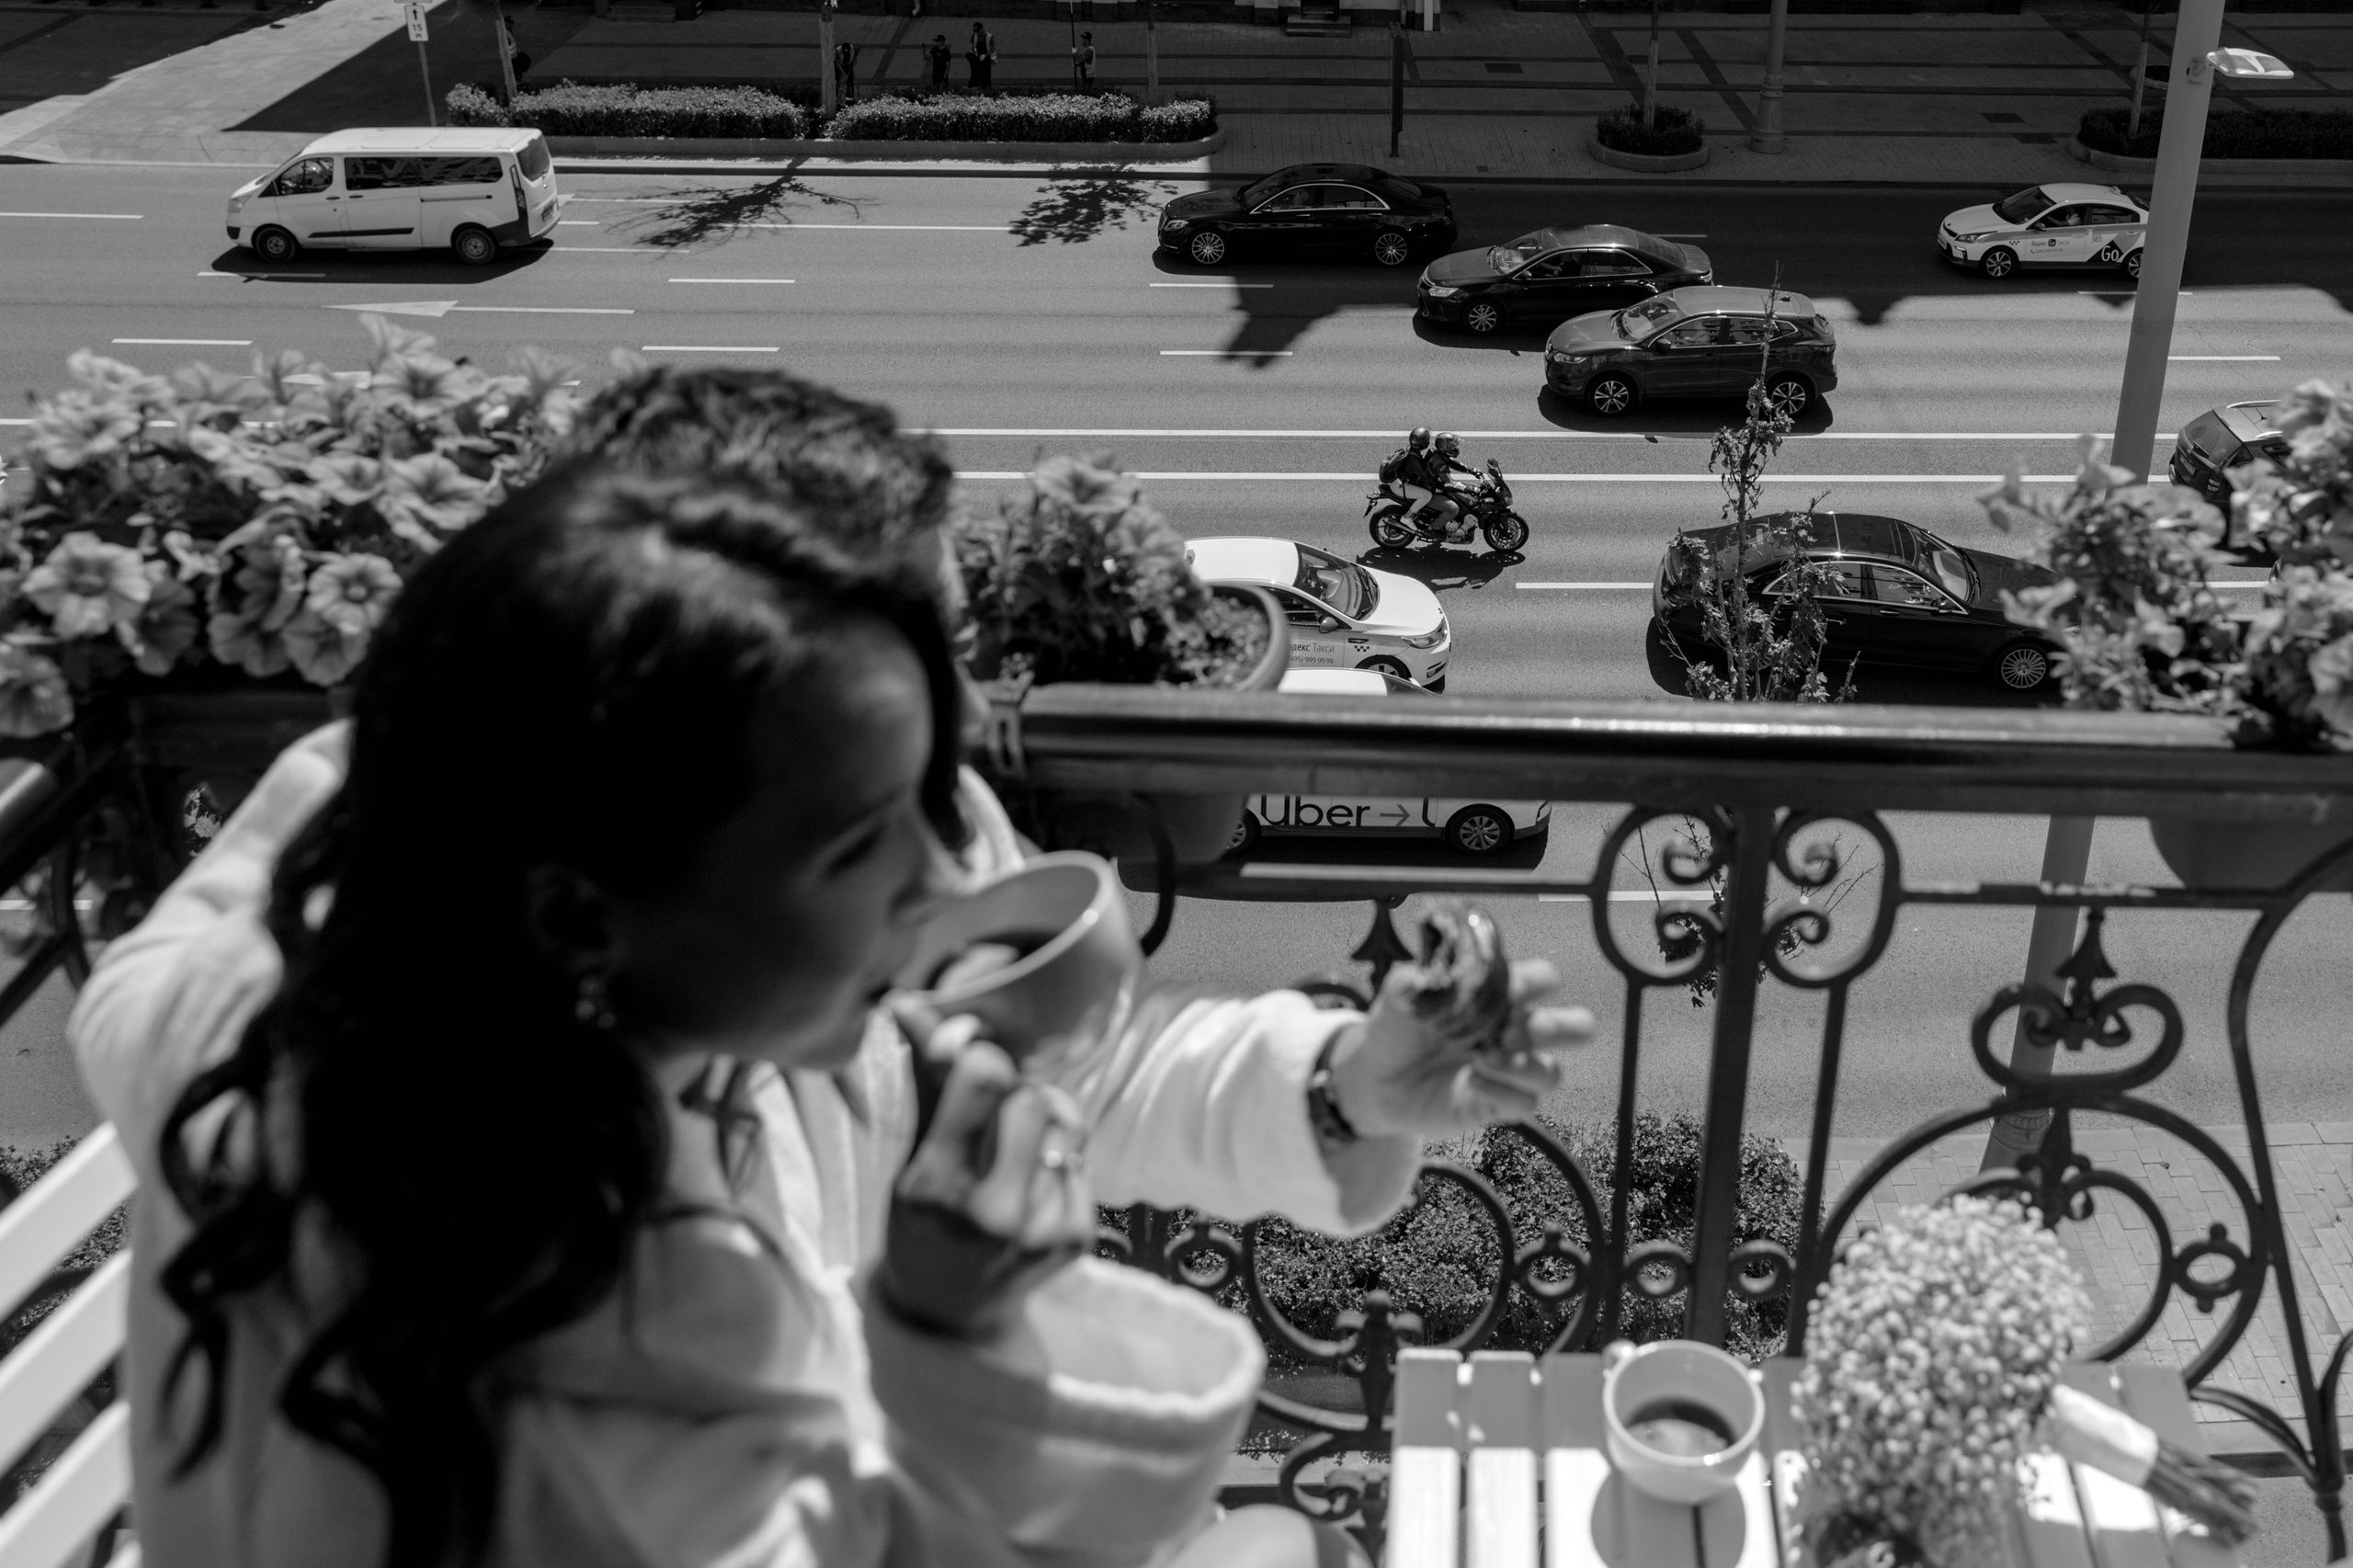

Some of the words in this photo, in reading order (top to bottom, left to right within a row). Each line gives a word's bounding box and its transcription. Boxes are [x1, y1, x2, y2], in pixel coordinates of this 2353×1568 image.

[2101, 245, 2120, 262] Go
[1290, 643, 1311, 653] декс
[1313, 642, 1335, 653] Такси
[1261, 794, 1370, 827] Uber
